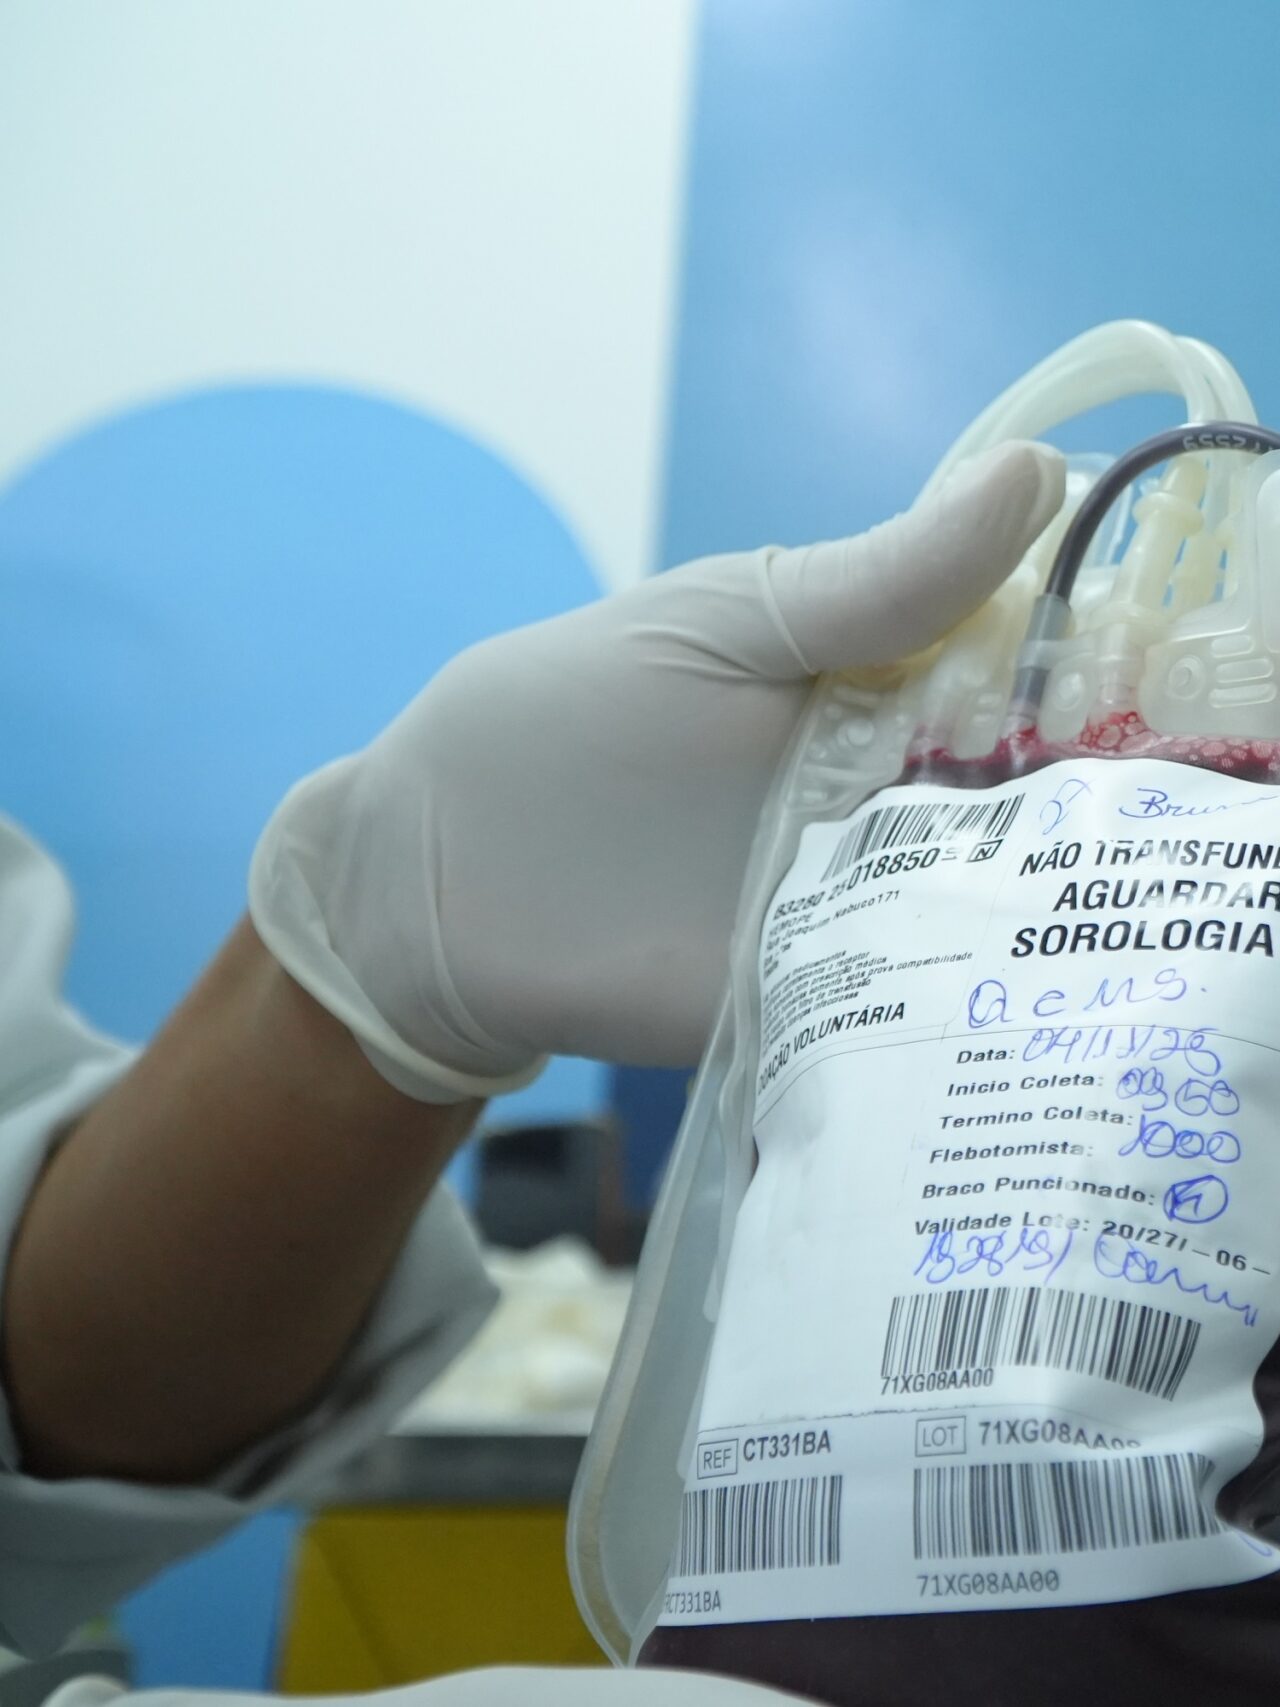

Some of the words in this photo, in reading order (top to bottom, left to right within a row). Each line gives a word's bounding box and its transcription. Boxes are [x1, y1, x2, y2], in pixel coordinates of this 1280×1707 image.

[1018, 839, 1081, 876] NÃO
[1011, 919, 1275, 958] SOROLOGIA
[896, 951, 973, 970] compatibilidade
[793, 1002, 906, 1055] VOLUNTÁRIA
[956, 1047, 1016, 1064] Data:
[947, 1080, 1010, 1097] Inicio
[1020, 1073, 1104, 1090] Coleta:
[939, 1110, 1033, 1130] Termino
[1043, 1105, 1134, 1126] Coleta:
[930, 1141, 1094, 1164] Flebotomista:
[922, 1181, 985, 1199] Braco
[995, 1176, 1156, 1207] Puncionado:
[914, 1213, 1012, 1236] Validade
[881, 1367, 995, 1395] 71XG08AA00
[923, 1425, 958, 1447] LOT
[979, 1419, 1142, 1451] 71XG08AA00
[702, 1450, 733, 1470] REF
[742, 1430, 832, 1461] CT331BA
[917, 1569, 1061, 1597] 71XG08AA00
